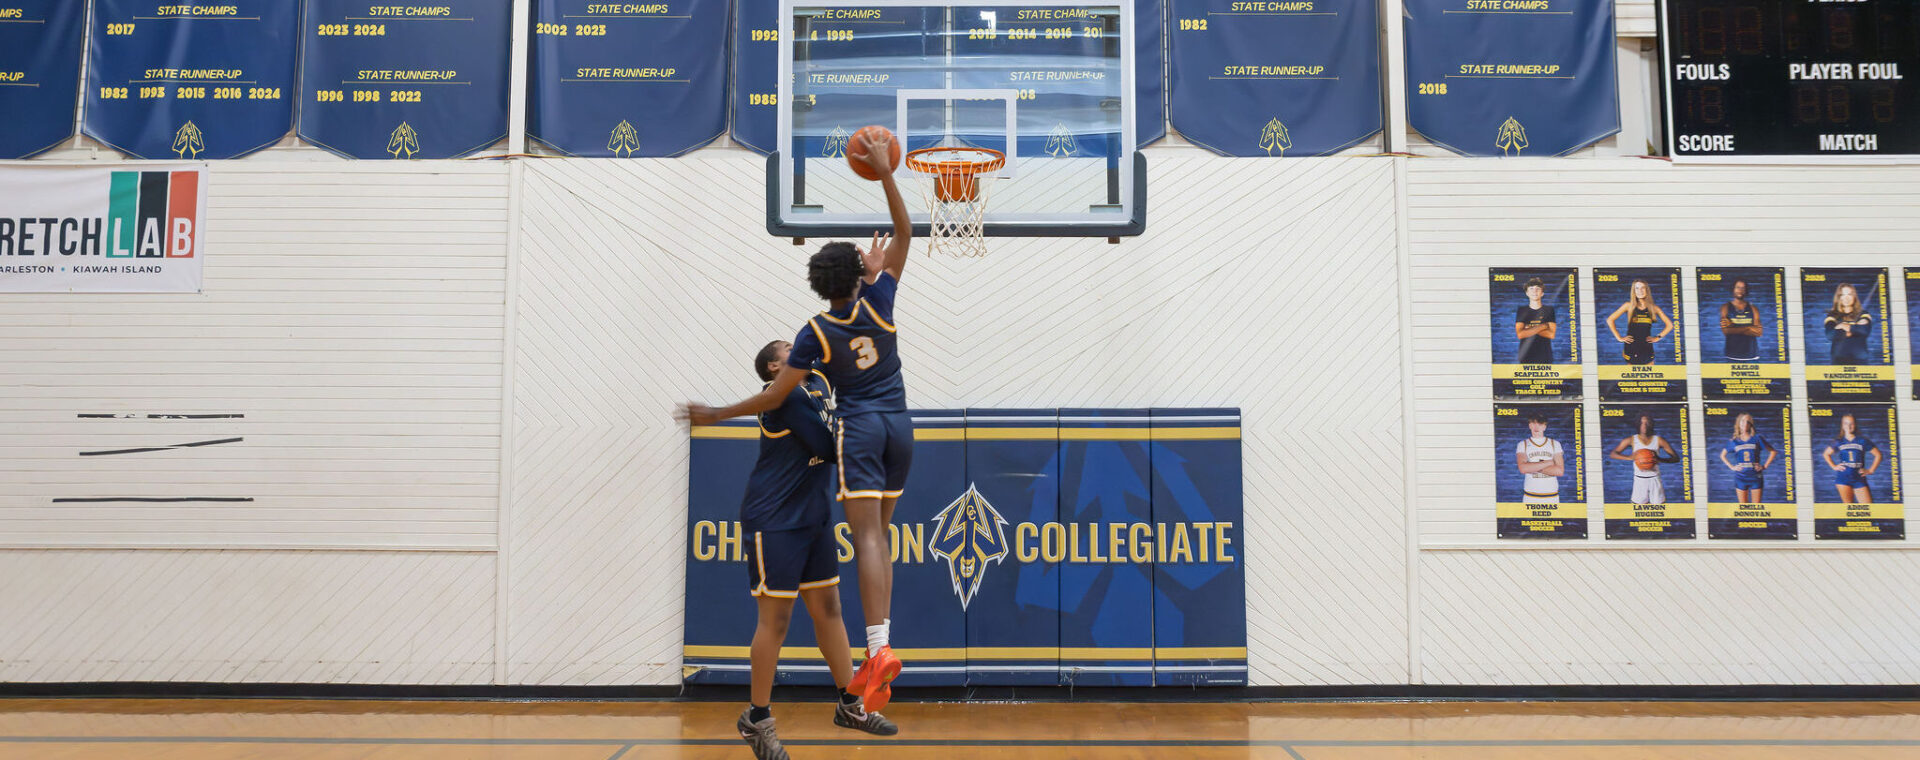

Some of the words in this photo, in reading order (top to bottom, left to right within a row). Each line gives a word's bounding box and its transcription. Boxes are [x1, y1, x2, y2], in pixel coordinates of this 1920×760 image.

[157, 6, 190, 15] STATE
[192, 6, 237, 15] CHAMPS
[588, 4, 621, 14] STATE
[623, 4, 668, 14] CHAMPS
[1232, 2, 1266, 11] STATE
[1268, 2, 1313, 11] CHAMPS
[1466, 0, 1501, 9] STATE
[1503, 0, 1549, 10] CHAMPS
[369, 6, 403, 16] STATE
[405, 7, 451, 16] CHAMPS
[836, 9, 881, 19] CHAMPS
[1018, 10, 1051, 19] STATE
[107, 24, 135, 35] 2017
[318, 24, 349, 35] 2023
[354, 24, 385, 36] 2024
[536, 23, 567, 36] 2002
[576, 25, 606, 36] 2023
[1180, 19, 1207, 30] 1982
[751, 30, 778, 41] 1992
[827, 30, 854, 41] 1995
[1008, 28, 1036, 39] 2014
[1045, 27, 1072, 39] 2016
[144, 69, 178, 79] STATE
[180, 69, 242, 79] RUNNER-UP
[577, 68, 611, 78] STATE
[612, 68, 675, 78] RUNNER-UP
[1224, 66, 1258, 75] STATE
[1260, 66, 1324, 75] RUNNER-UP
[1460, 64, 1494, 74] STATE
[1496, 65, 1559, 74] RUNNER-UP
[1676, 64, 1730, 80] FOULS
[1790, 63, 1853, 80] PLAYER
[1859, 63, 1903, 80] FOUL
[358, 70, 392, 80] STATE
[394, 71, 456, 80] RUNNER-UP
[826, 74, 889, 83] RUNNER-UP
[1010, 71, 1044, 81] STATE
[101, 87, 128, 99] 1982
[140, 87, 165, 98] 1993
[177, 88, 205, 99] 2015
[214, 88, 242, 99] 2016
[249, 88, 280, 99] 2024
[1419, 83, 1447, 94] 2018
[317, 90, 344, 102] 1996
[353, 90, 380, 102] 1998
[390, 90, 421, 102] 2022
[750, 94, 777, 105] 1985
[1679, 134, 1735, 151] SCORE
[1819, 134, 1877, 151] MATCH
[849, 336, 879, 370] 3
[1015, 521, 1234, 563] COLLEGIATE
